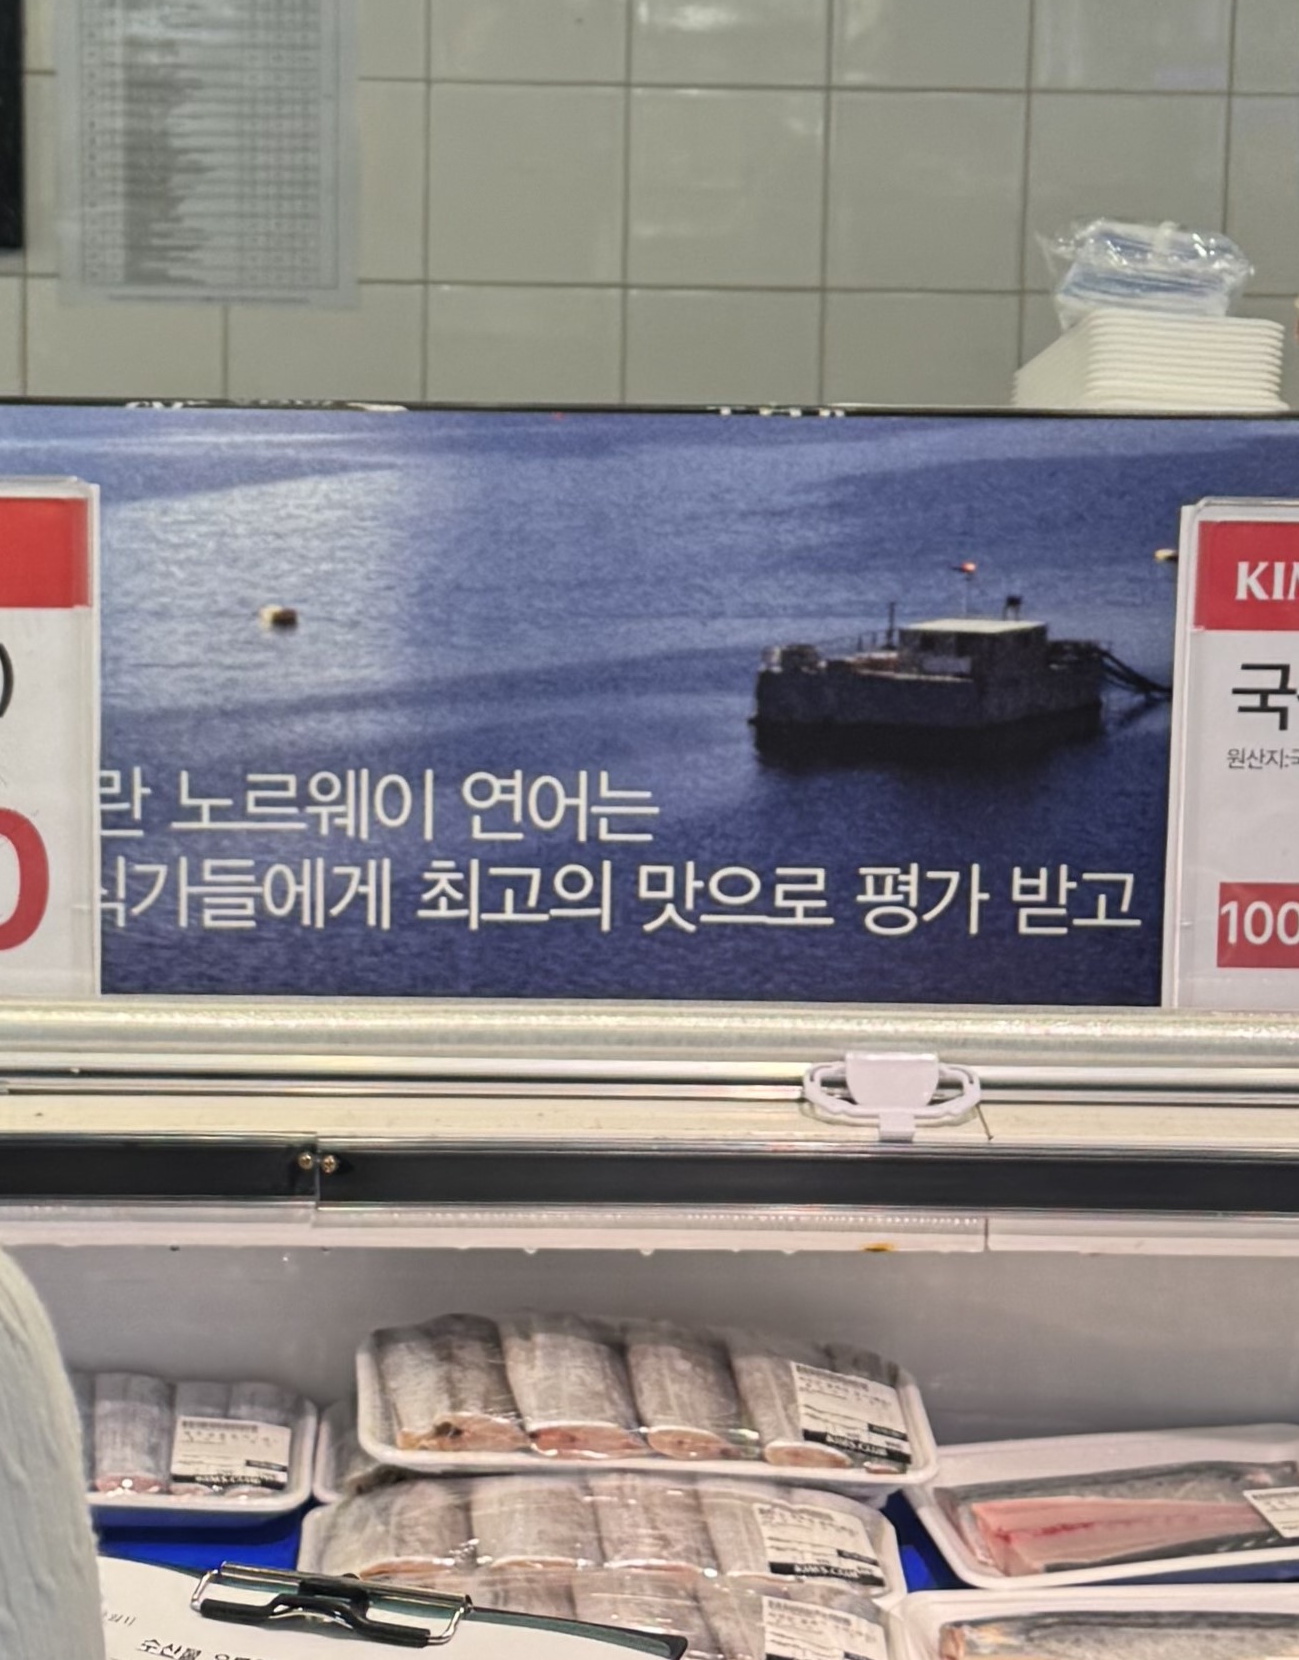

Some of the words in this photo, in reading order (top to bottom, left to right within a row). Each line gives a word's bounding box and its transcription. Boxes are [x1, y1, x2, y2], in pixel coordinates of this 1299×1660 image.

[171, 768, 434, 841] 노르웨이
[462, 769, 660, 842] 연어는
[417, 858, 611, 932] 최고의
[638, 859, 835, 933] 맛으로
[856, 861, 990, 936] 평가
[1012, 863, 1142, 935] 받고
